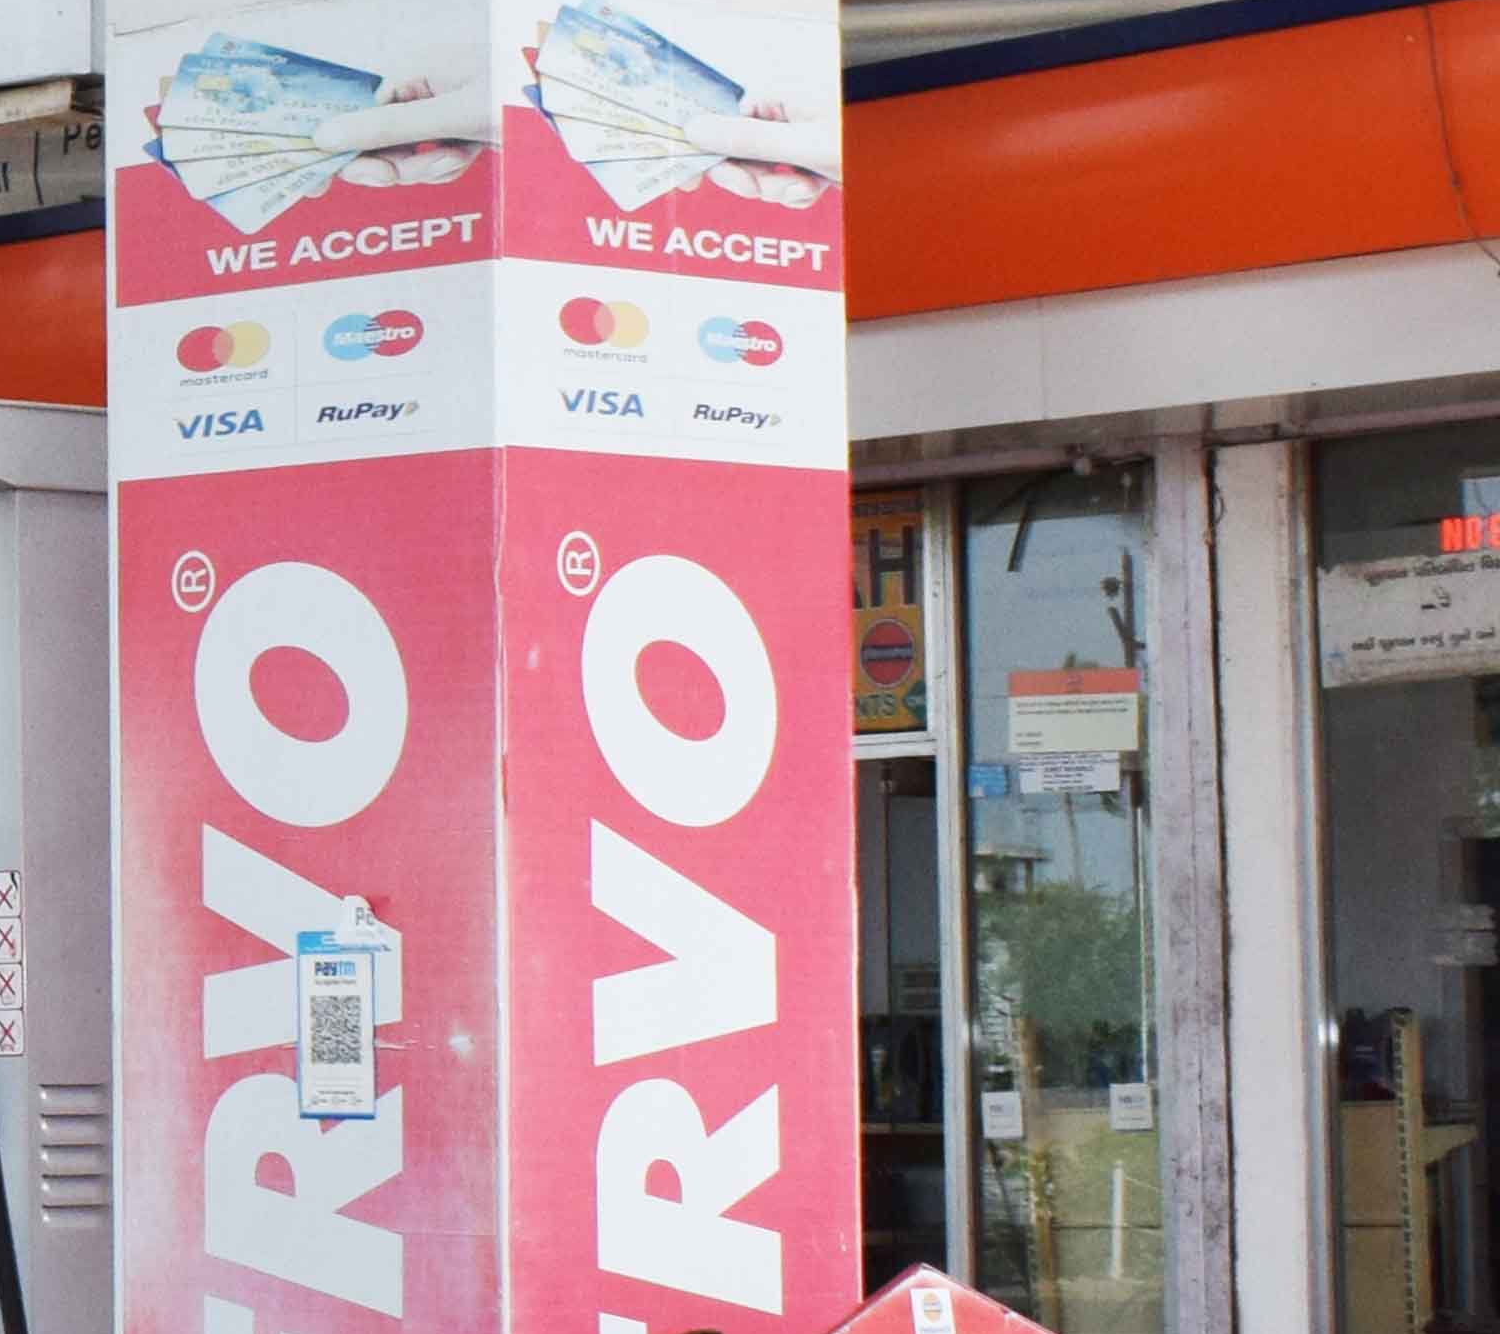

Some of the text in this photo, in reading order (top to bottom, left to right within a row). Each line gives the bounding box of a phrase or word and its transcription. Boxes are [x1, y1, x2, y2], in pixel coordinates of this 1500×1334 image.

[207, 212, 482, 275] WE ACCEPT
[587, 216, 830, 272] WE ACCEPT
[332, 322, 417, 348] Maestro
[701, 332, 778, 356] Maestro
[563, 346, 650, 364] mastercard
[180, 369, 269, 388] mastercard
[316, 401, 405, 426] RuPay
[560, 389, 645, 419] VISA
[692, 403, 772, 430] RuPay
[177, 410, 265, 440] VISA
